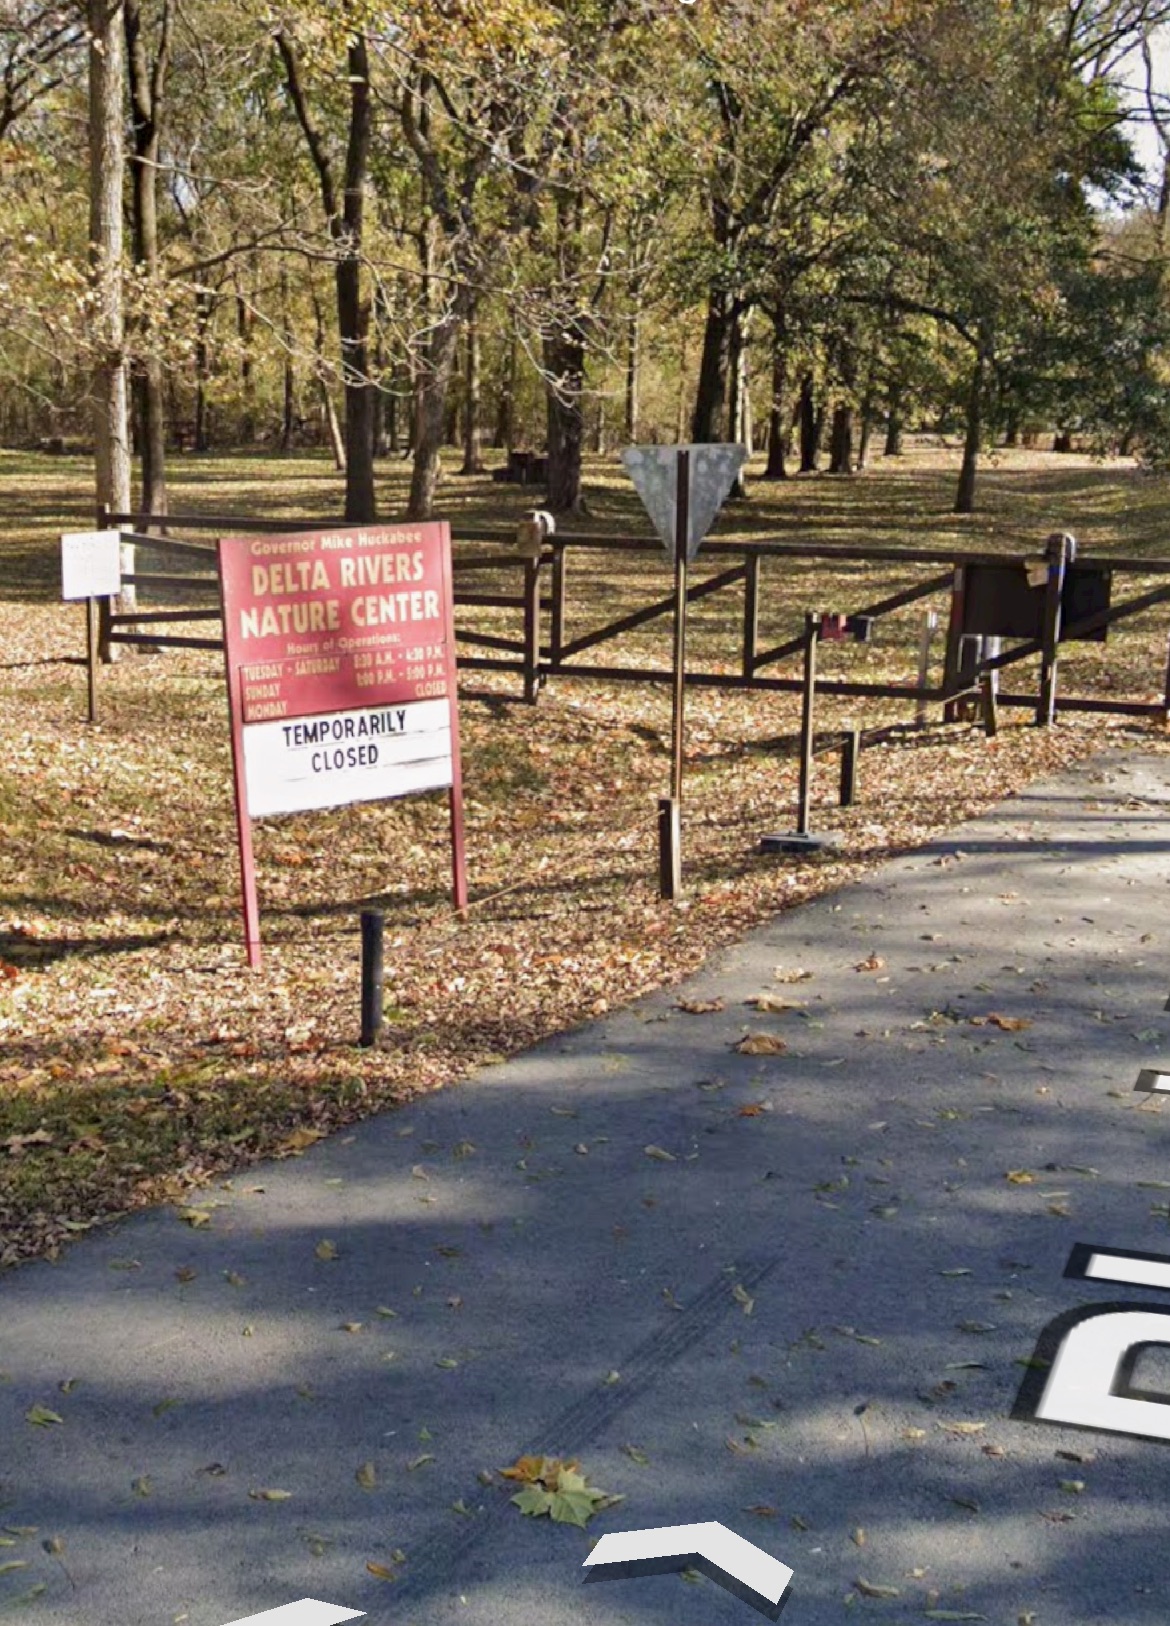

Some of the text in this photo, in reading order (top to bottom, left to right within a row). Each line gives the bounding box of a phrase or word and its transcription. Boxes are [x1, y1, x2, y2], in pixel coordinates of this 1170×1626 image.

[251, 530, 422, 556] Governor Mike Huckabee
[252, 552, 424, 596] DELTA RIVERS
[240, 590, 440, 638] NATURE CENTER
[287, 641, 318, 654] Hours
[322, 638, 335, 650] of
[243, 664, 283, 681] TUESDAY
[295, 657, 340, 676] SATURDAY
[246, 683, 280, 701] SUNDAY
[416, 680, 447, 697] CLOSED
[248, 701, 287, 720] MONDAY
[282, 710, 406, 747] TEMPORARILY
[312, 744, 379, 772] CLOSED
